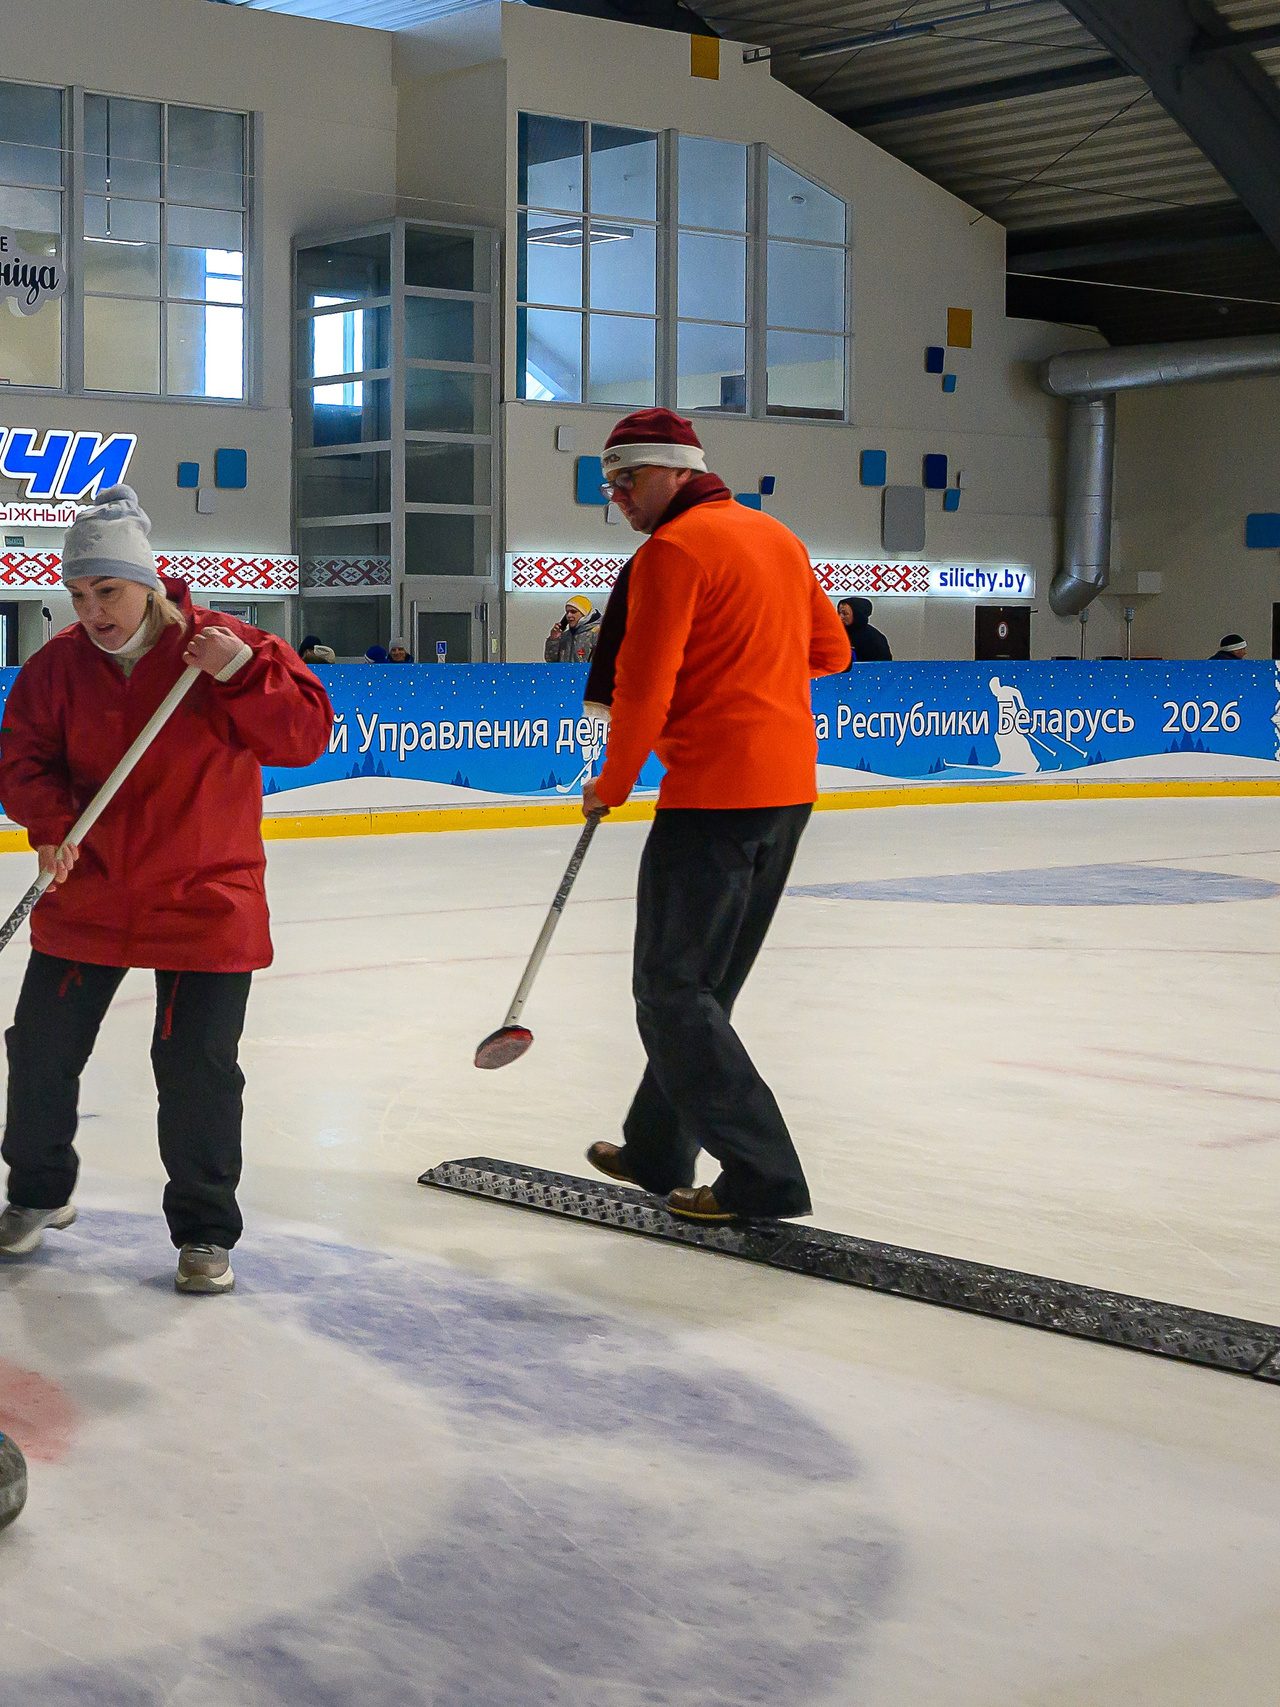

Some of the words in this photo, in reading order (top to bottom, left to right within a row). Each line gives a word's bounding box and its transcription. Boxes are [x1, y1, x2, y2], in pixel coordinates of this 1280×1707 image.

[939, 567, 1027, 593] silichy.by
[356, 713, 549, 762] Управления
[836, 701, 990, 747] Республики
[996, 699, 1136, 743] Беларусь
[1161, 700, 1243, 734] 2026
